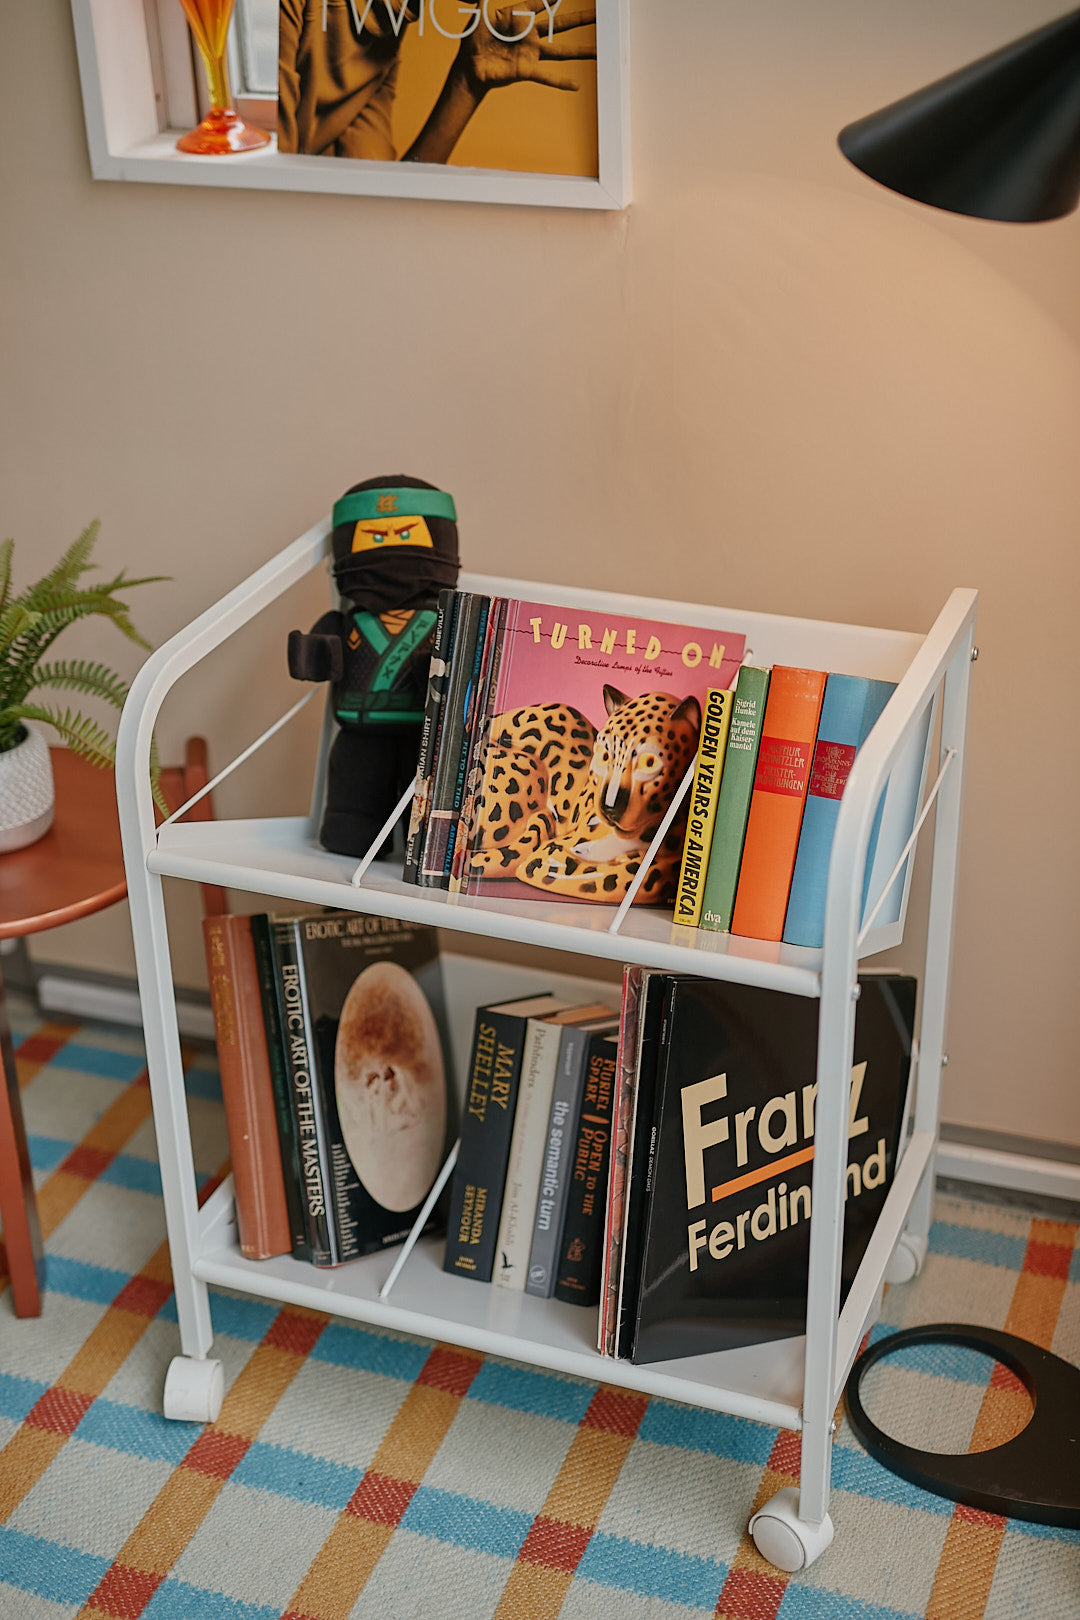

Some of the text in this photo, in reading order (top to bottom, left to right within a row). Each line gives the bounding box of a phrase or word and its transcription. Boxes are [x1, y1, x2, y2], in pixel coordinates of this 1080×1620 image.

[530, 617, 725, 669] TURNED ON
[703, 691, 725, 759] GOLDEN
[731, 717, 756, 729] Kamele
[734, 706, 756, 716] Hunke
[736, 698, 756, 709] Sigrid
[421, 714, 431, 746] SHIRT
[730, 726, 756, 736] auf dem
[730, 742, 752, 751] mantel
[731, 735, 754, 744] Kaiser-
[769, 743, 801, 757] ARTHUR
[761, 752, 805, 768] SCHNITZLER
[693, 762, 715, 819] YEARS
[690, 819, 704, 839] OF
[678, 837, 703, 917] AMERICA
[305, 919, 344, 940] EROTIC
[346, 917, 363, 935] ART
[364, 916, 379, 933] OF
[704, 910, 721, 924] dva
[282, 964, 304, 1030] EROTIC
[290, 1033, 308, 1068] ART
[468, 1022, 496, 1122] SHELLEY
[294, 1069, 312, 1095] OF
[490, 1043, 515, 1110] MARY
[585, 1055, 603, 1103] SPARK
[599, 1058, 616, 1110] MURIEL
[298, 1096, 316, 1139] THE
[302, 1139, 326, 1218] MASTERS
[538, 1101, 569, 1231] the semantic turn
[575, 1127, 594, 1182] PUBLIC
[582, 1130, 608, 1216] OPEN TO THE
[458, 1184, 478, 1243] SEYMOUR
[469, 1187, 488, 1246] MIRANDA
[687, 1138, 887, 1272] Ferdinnd
